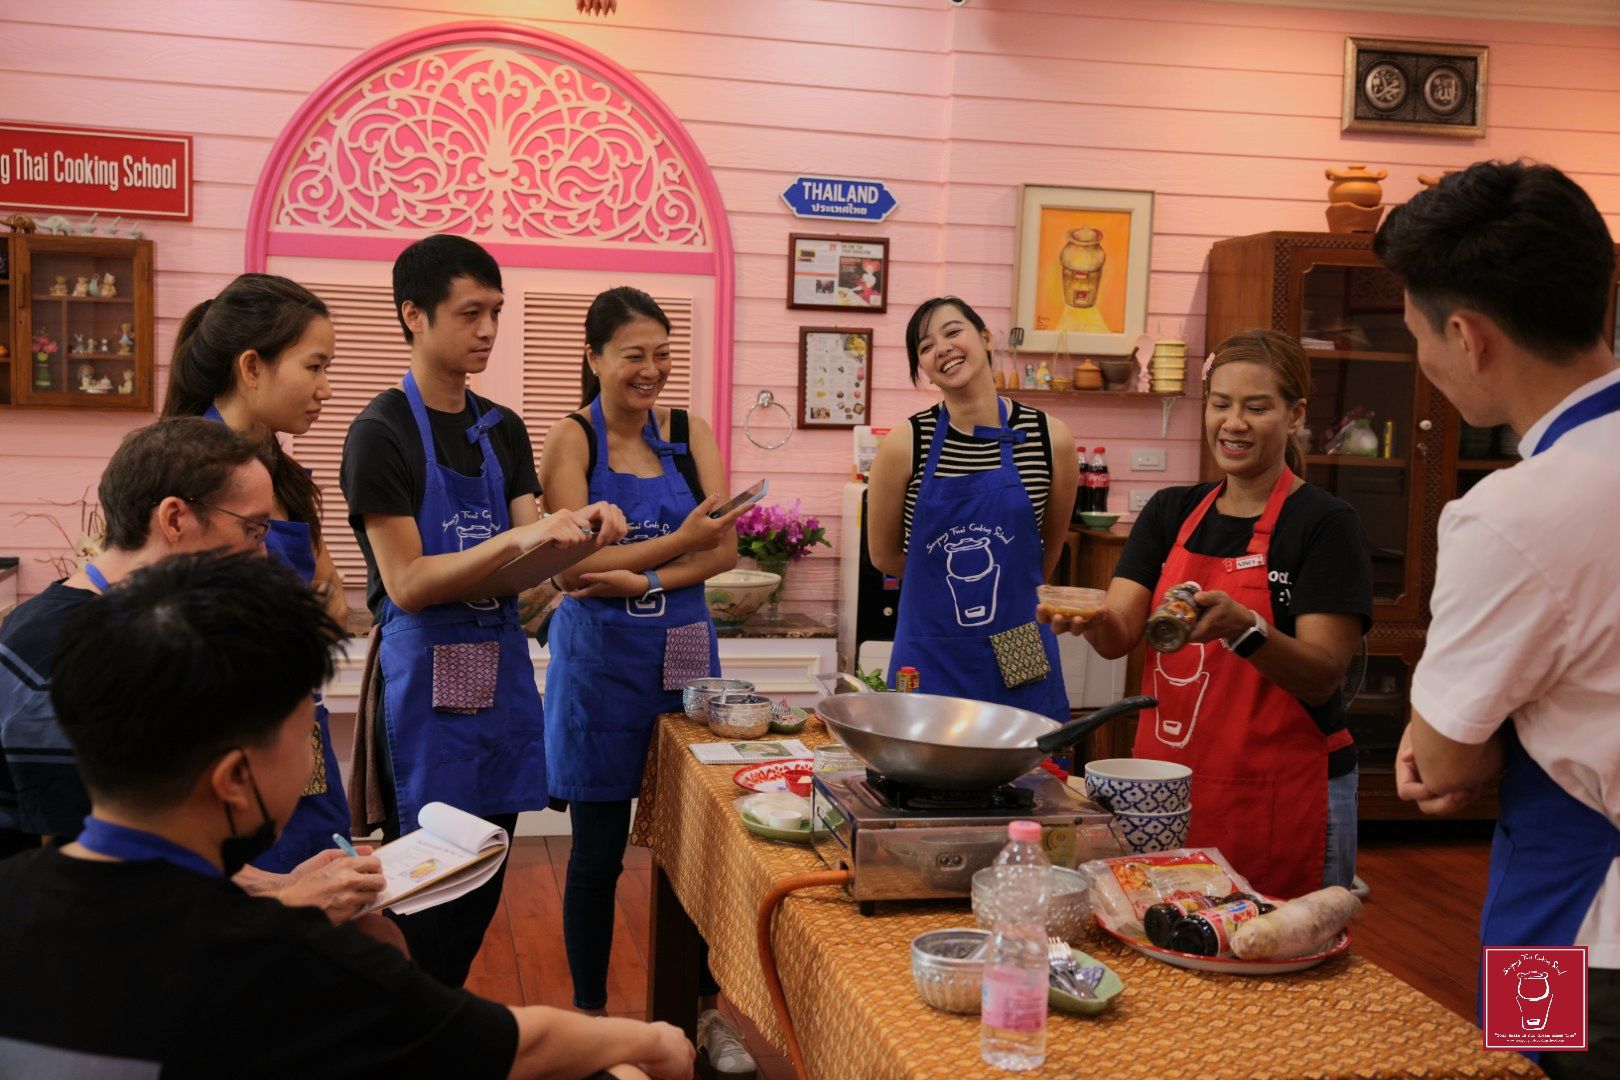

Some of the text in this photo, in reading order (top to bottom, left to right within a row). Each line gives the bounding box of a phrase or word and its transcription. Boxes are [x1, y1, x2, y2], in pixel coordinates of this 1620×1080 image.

[13, 148, 49, 182] Thai
[54, 150, 119, 191] Cooking
[123, 154, 177, 190] School
[802, 181, 879, 205] THAILAND
[811, 203, 868, 215] ประเทศไทย
